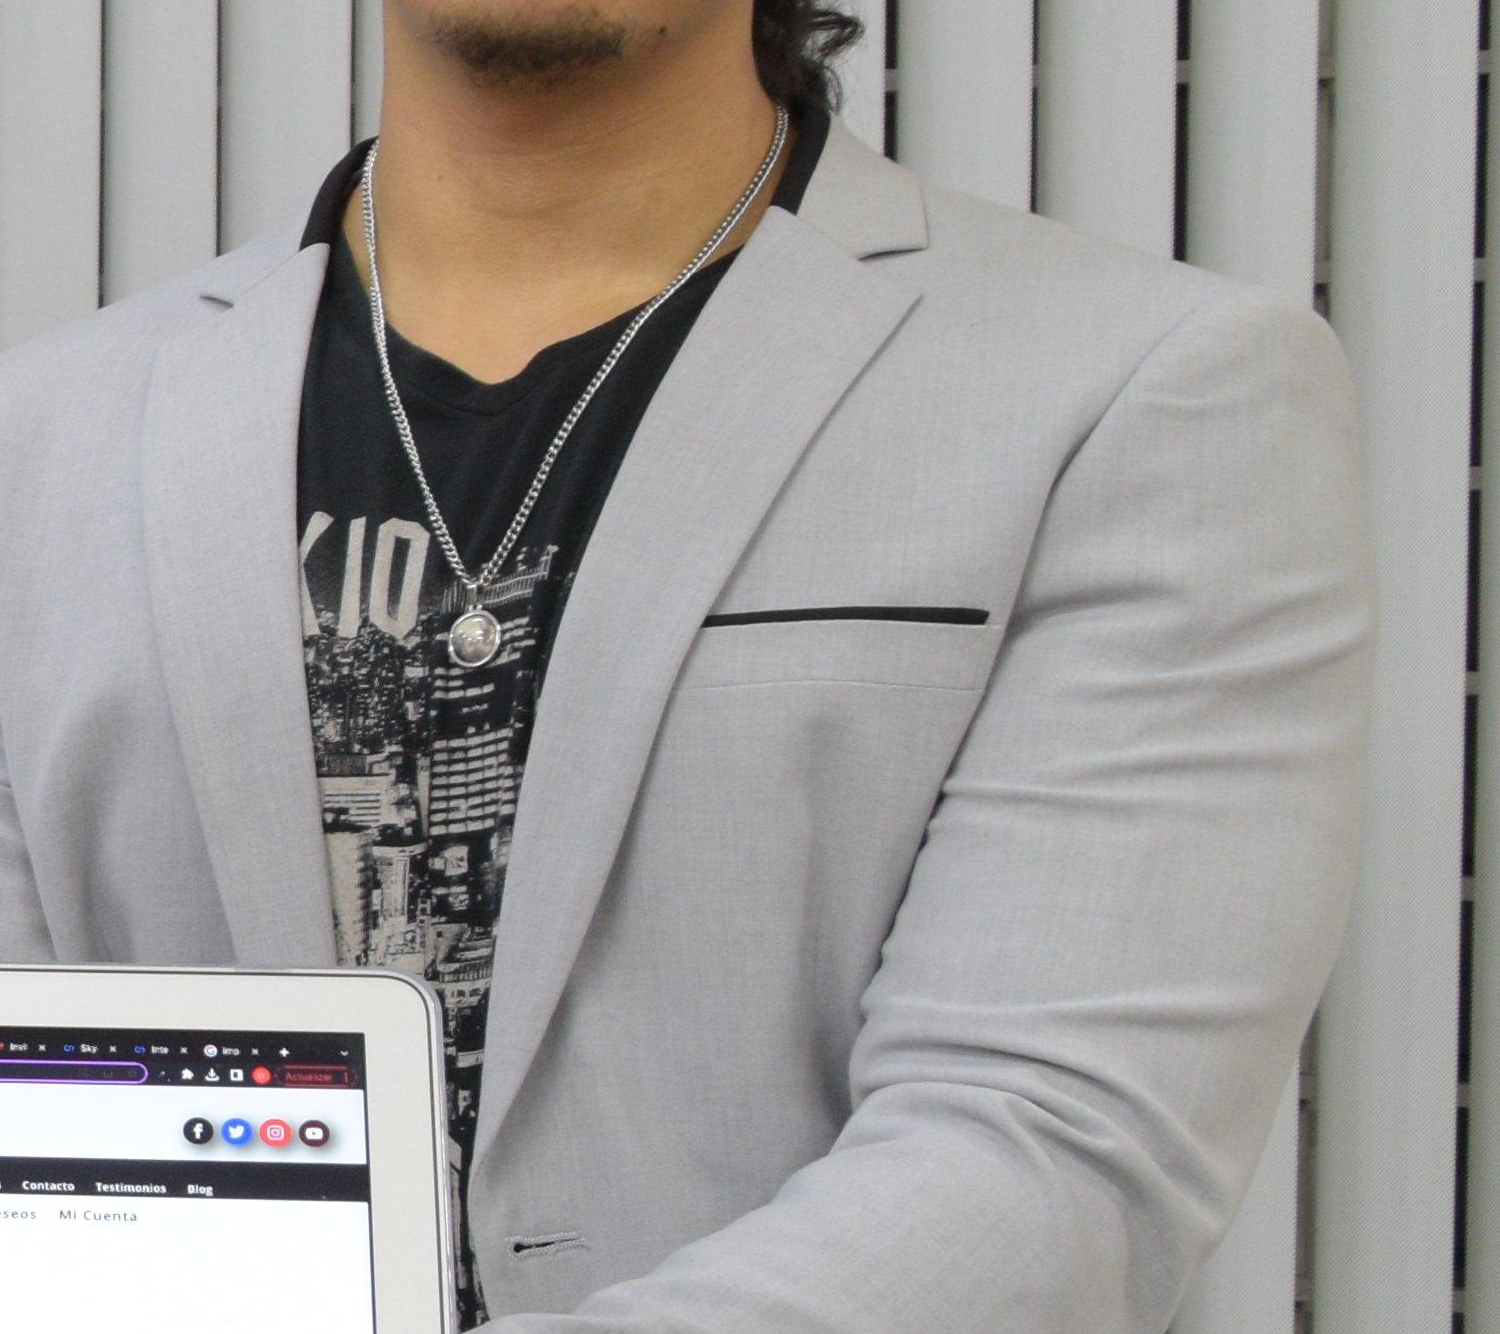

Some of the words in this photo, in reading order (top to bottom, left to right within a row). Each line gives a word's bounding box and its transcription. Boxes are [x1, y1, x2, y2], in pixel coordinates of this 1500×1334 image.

[22, 1180, 74, 1191] Contacto
[95, 1182, 166, 1193] Testimonios
[187, 1184, 213, 1196] Blog
[59, 1209, 76, 1219] Mi
[83, 1210, 137, 1221] Cuenta
